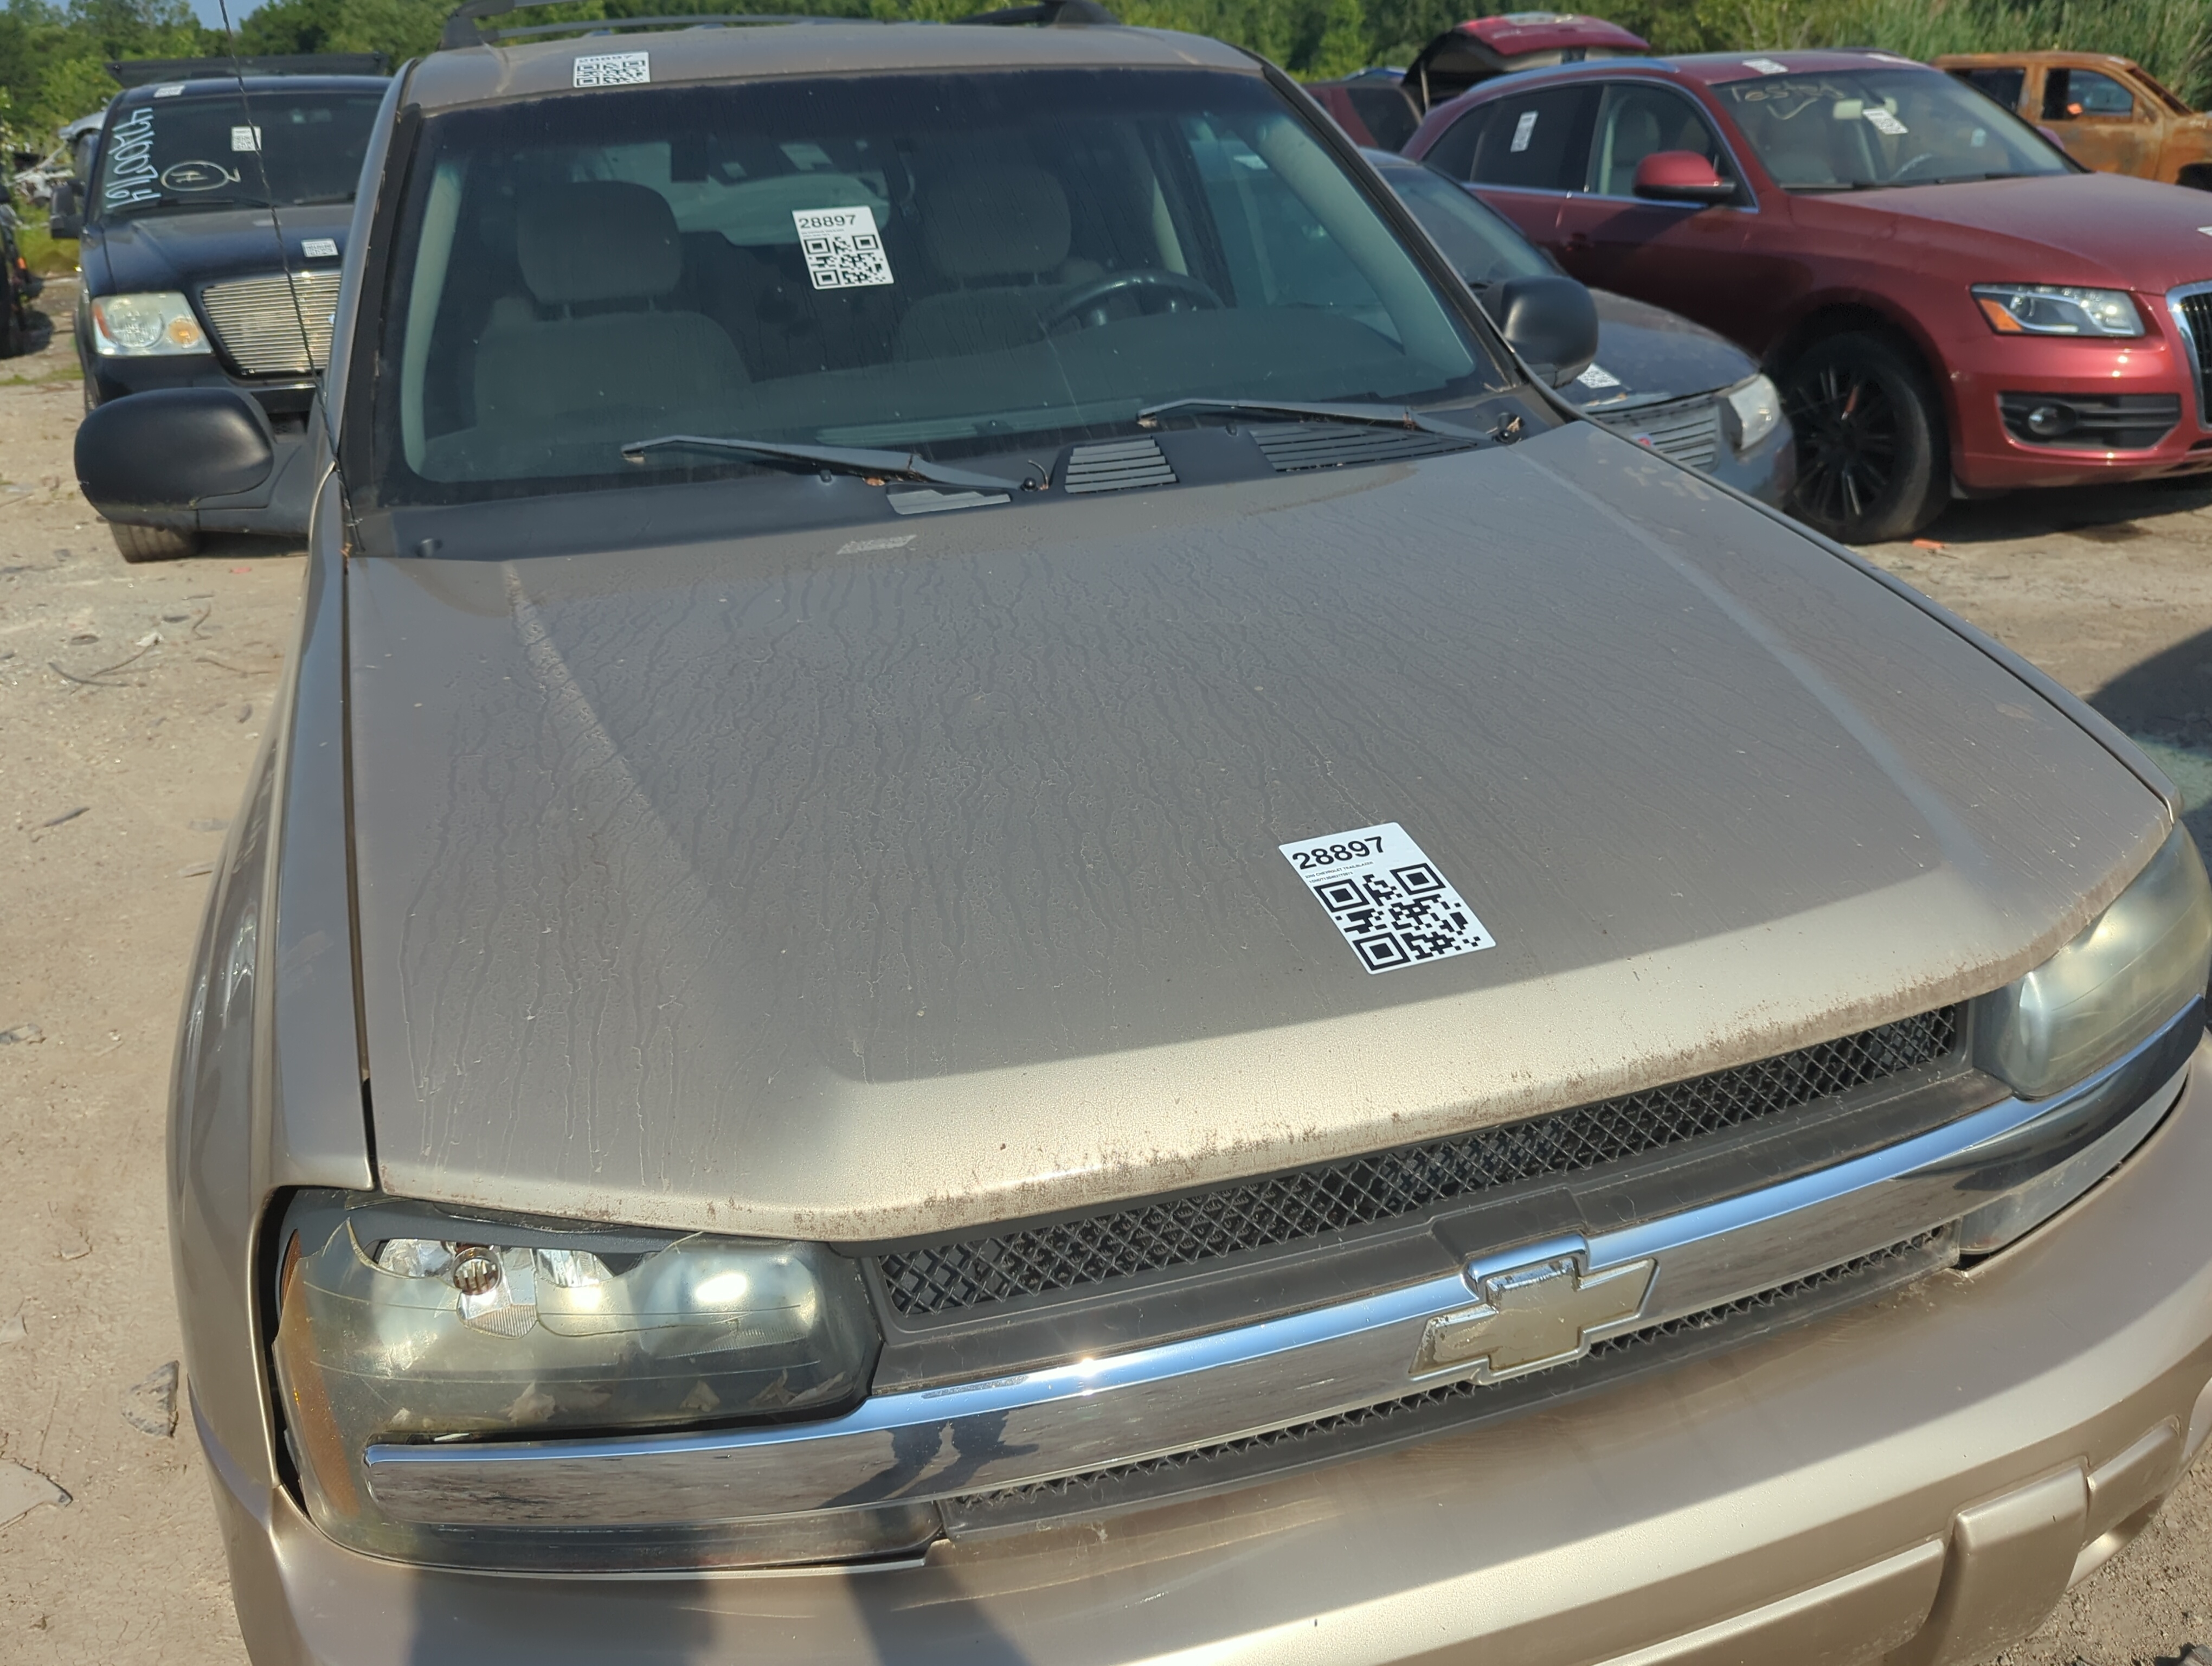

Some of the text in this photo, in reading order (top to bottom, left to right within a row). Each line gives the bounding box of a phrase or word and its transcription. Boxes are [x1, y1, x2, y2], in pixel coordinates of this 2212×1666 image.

[799, 215, 856, 229] 28897
[1292, 836, 1384, 870] 28897
[1316, 868, 1342, 876] CHEVROLET
[1343, 861, 1374, 871] TRAILBLAZER
